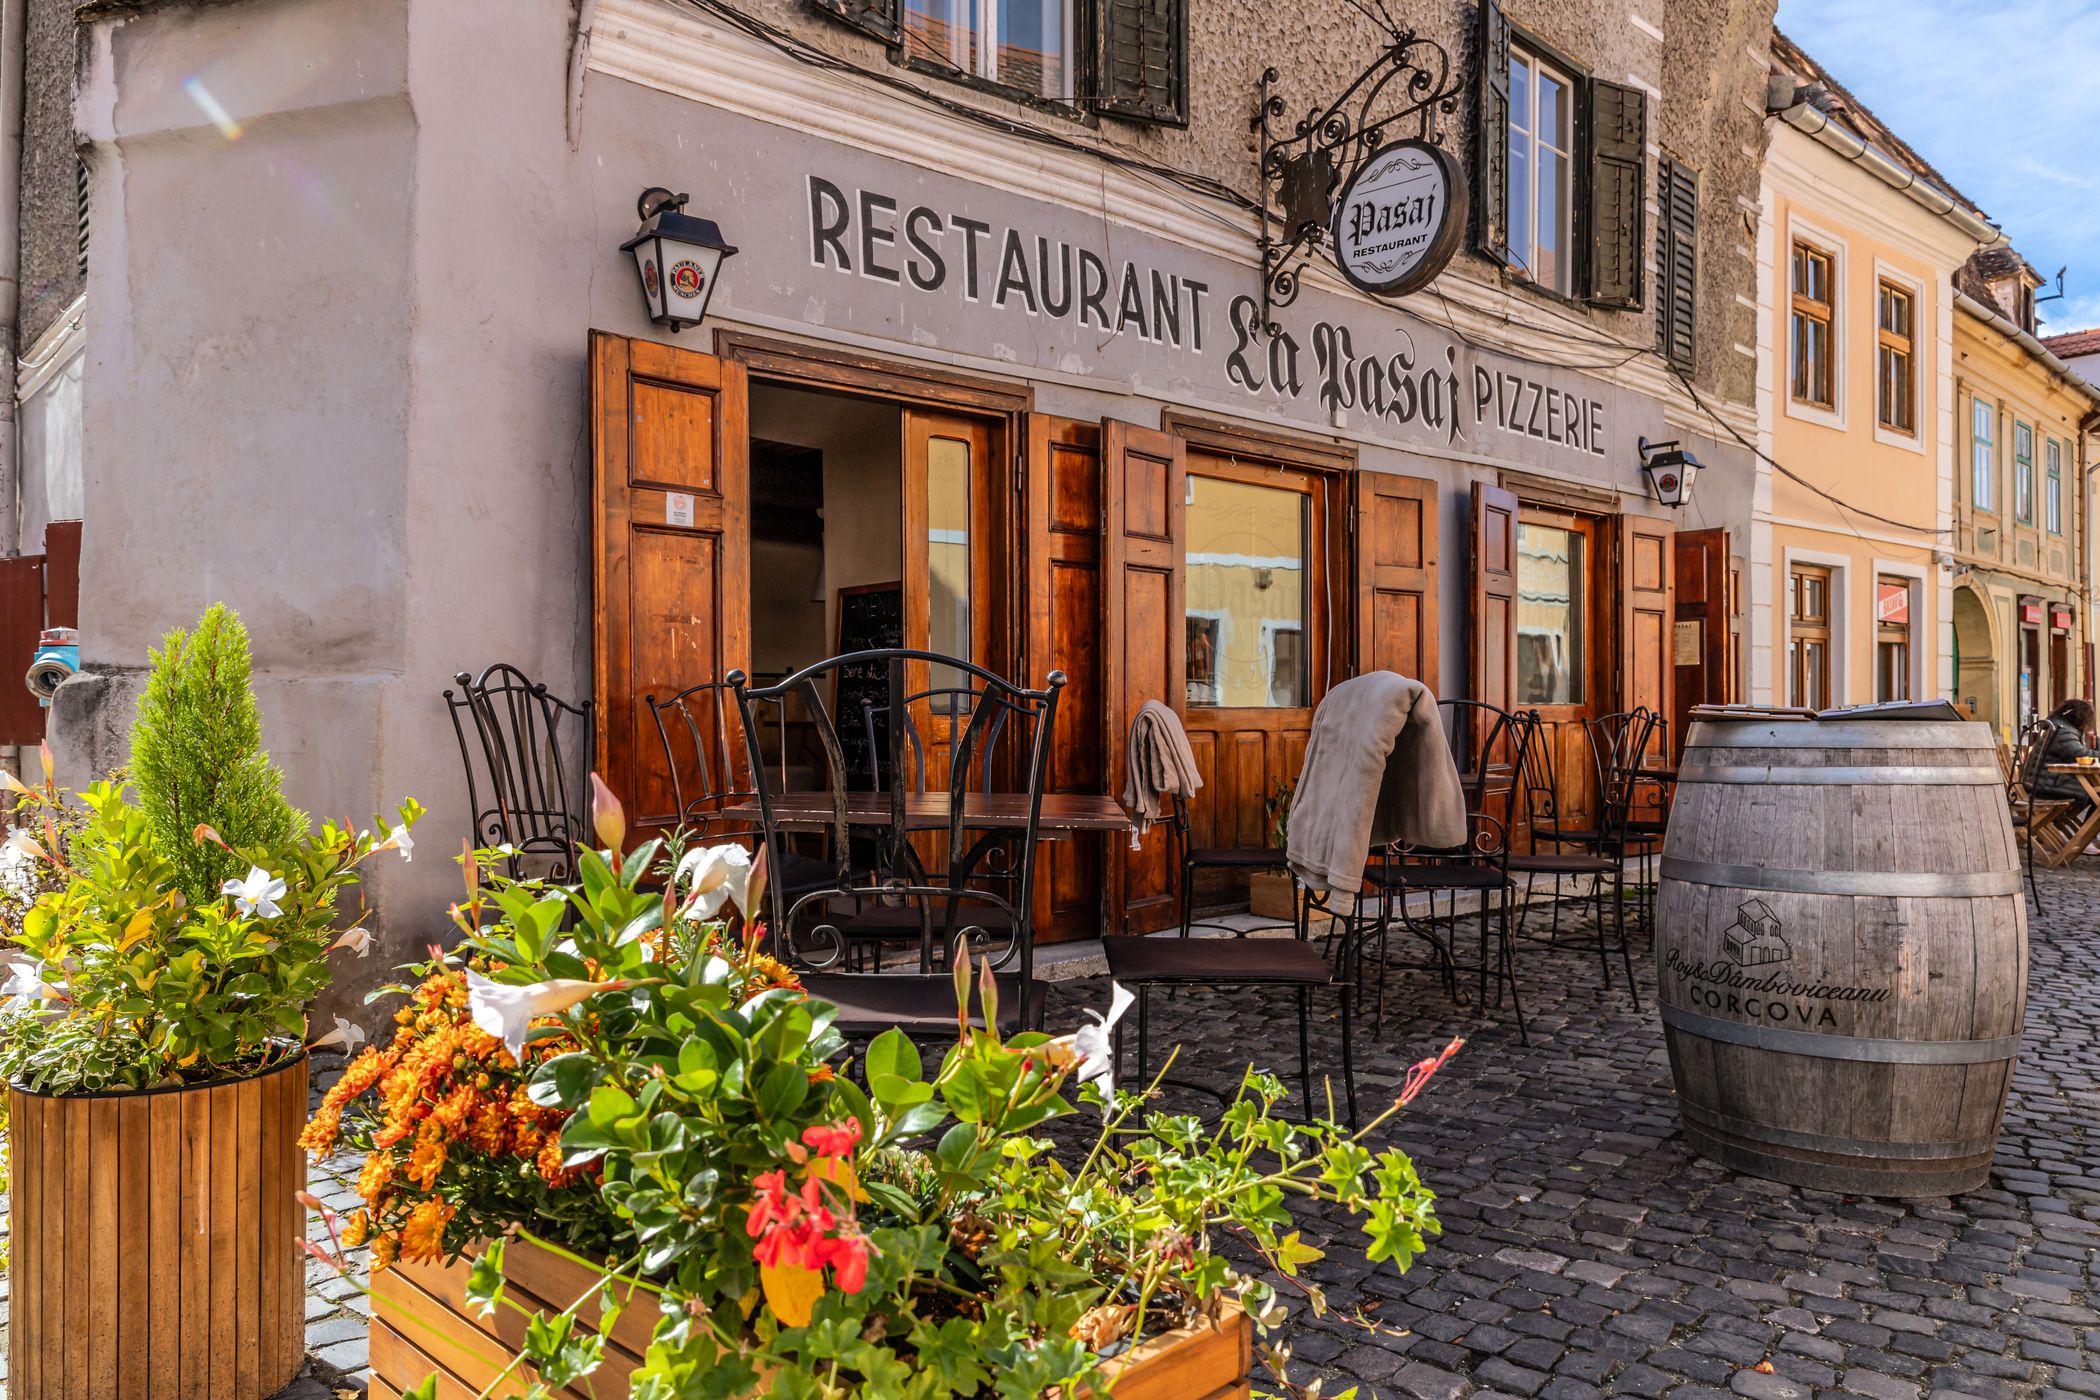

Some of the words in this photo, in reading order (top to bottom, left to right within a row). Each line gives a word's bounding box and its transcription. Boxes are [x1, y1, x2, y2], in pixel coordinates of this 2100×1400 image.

[1347, 184, 1437, 247] Pasaj
[1353, 234, 1428, 259] RESTAURANT
[806, 175, 1208, 354] RESTAURANT
[1225, 294, 1304, 400] La
[1310, 321, 1466, 446] Pasaj
[1472, 365, 1605, 456] PIZZERIE
[1691, 986, 1837, 1027] CORCOVA
